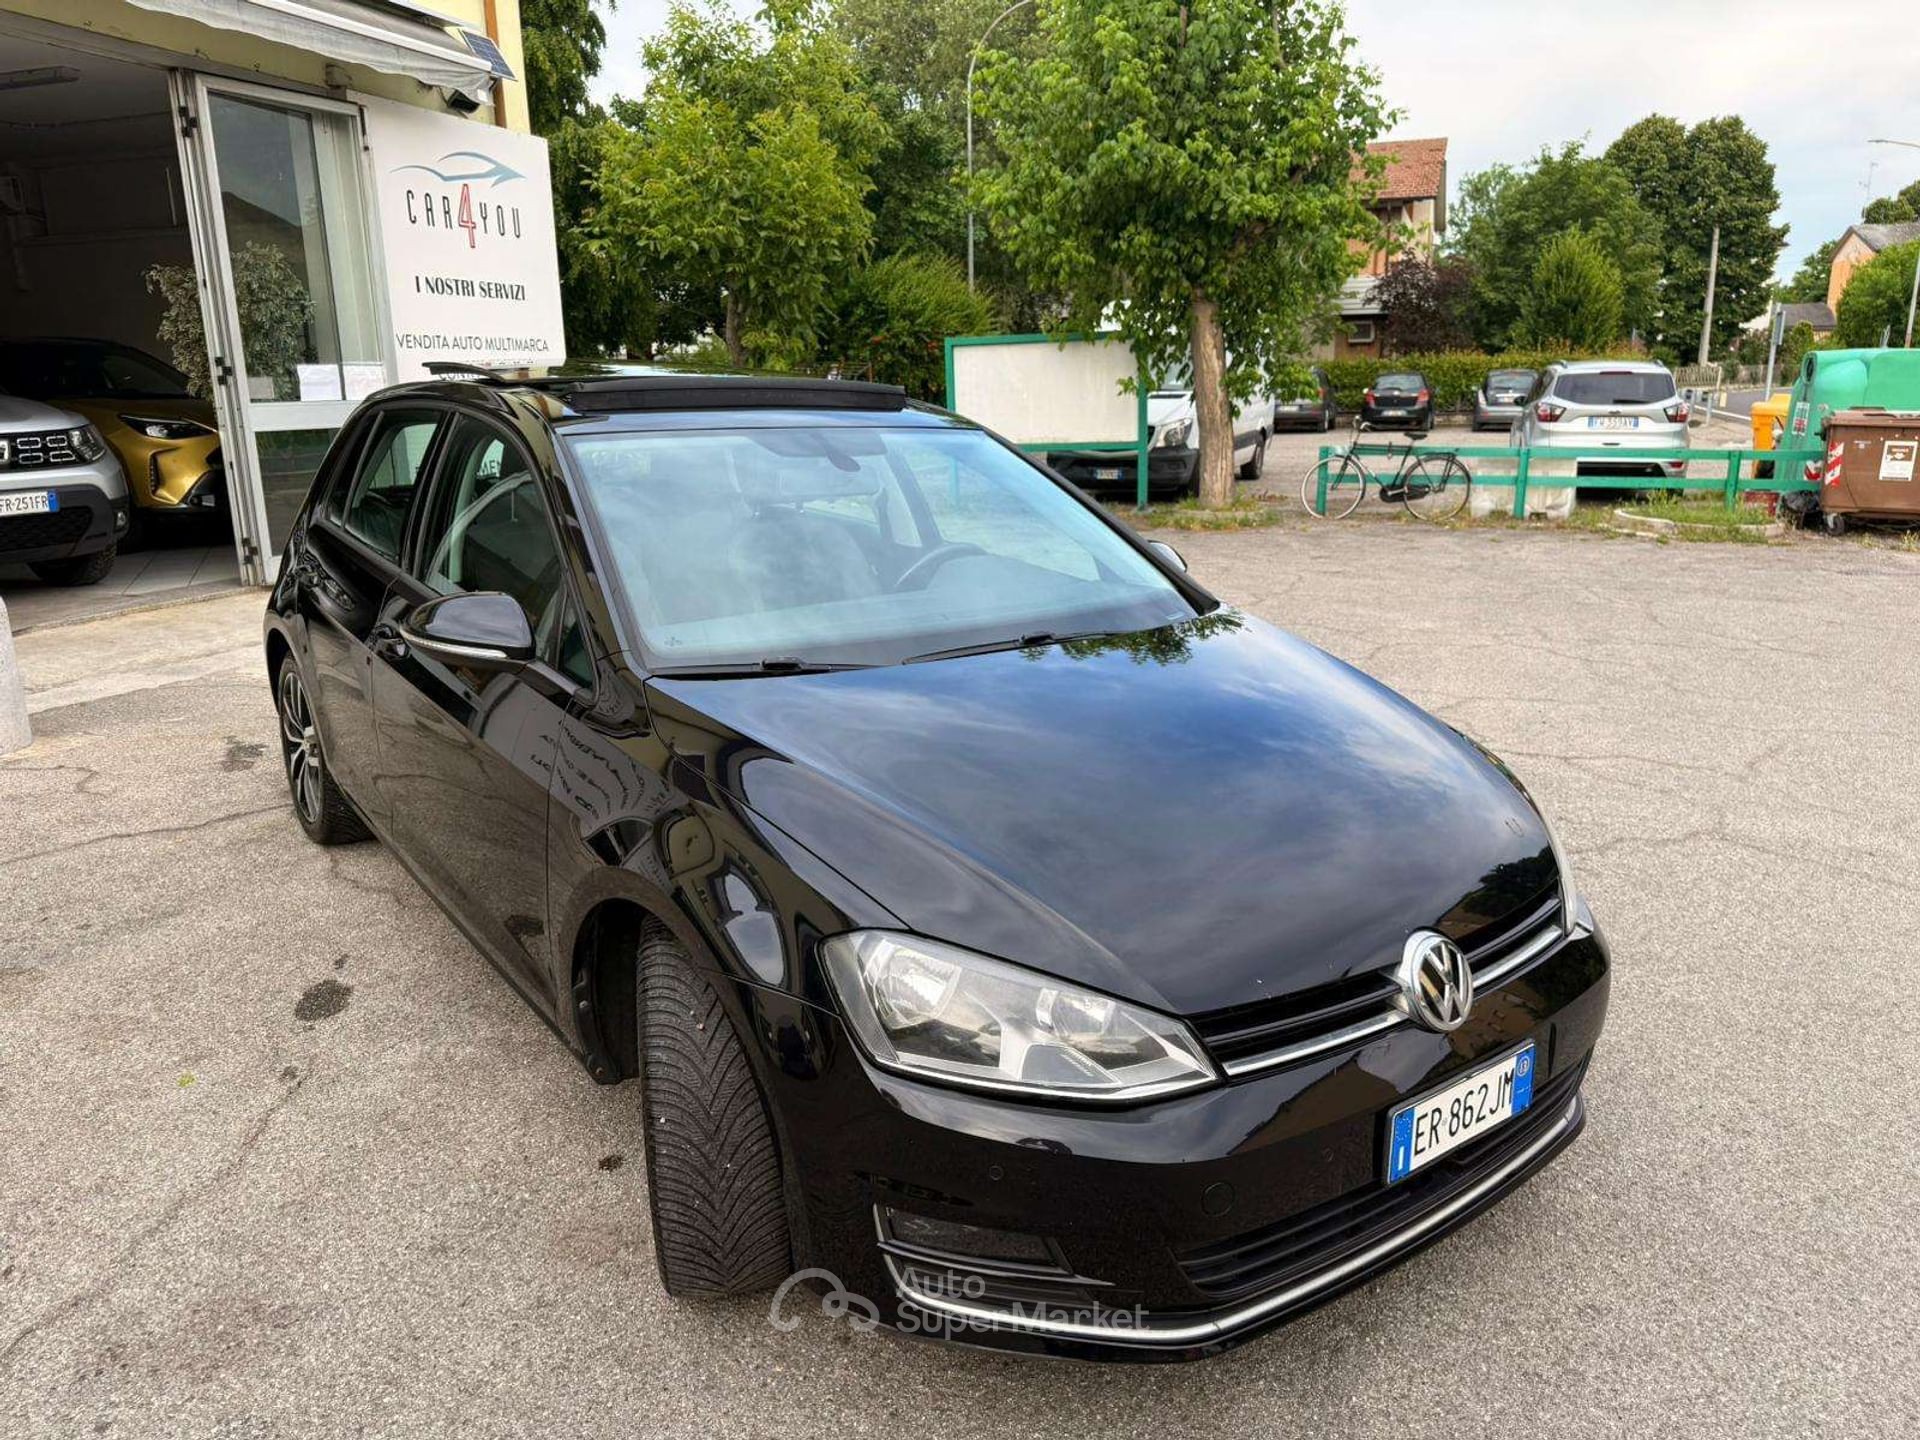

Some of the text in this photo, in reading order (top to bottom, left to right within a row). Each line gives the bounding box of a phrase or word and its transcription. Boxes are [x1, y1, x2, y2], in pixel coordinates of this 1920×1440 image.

[415, 275, 526, 301] I NOSTRI SERVIZI
[396, 333, 549, 352] VENDITA AUTO MULTIMARCA
